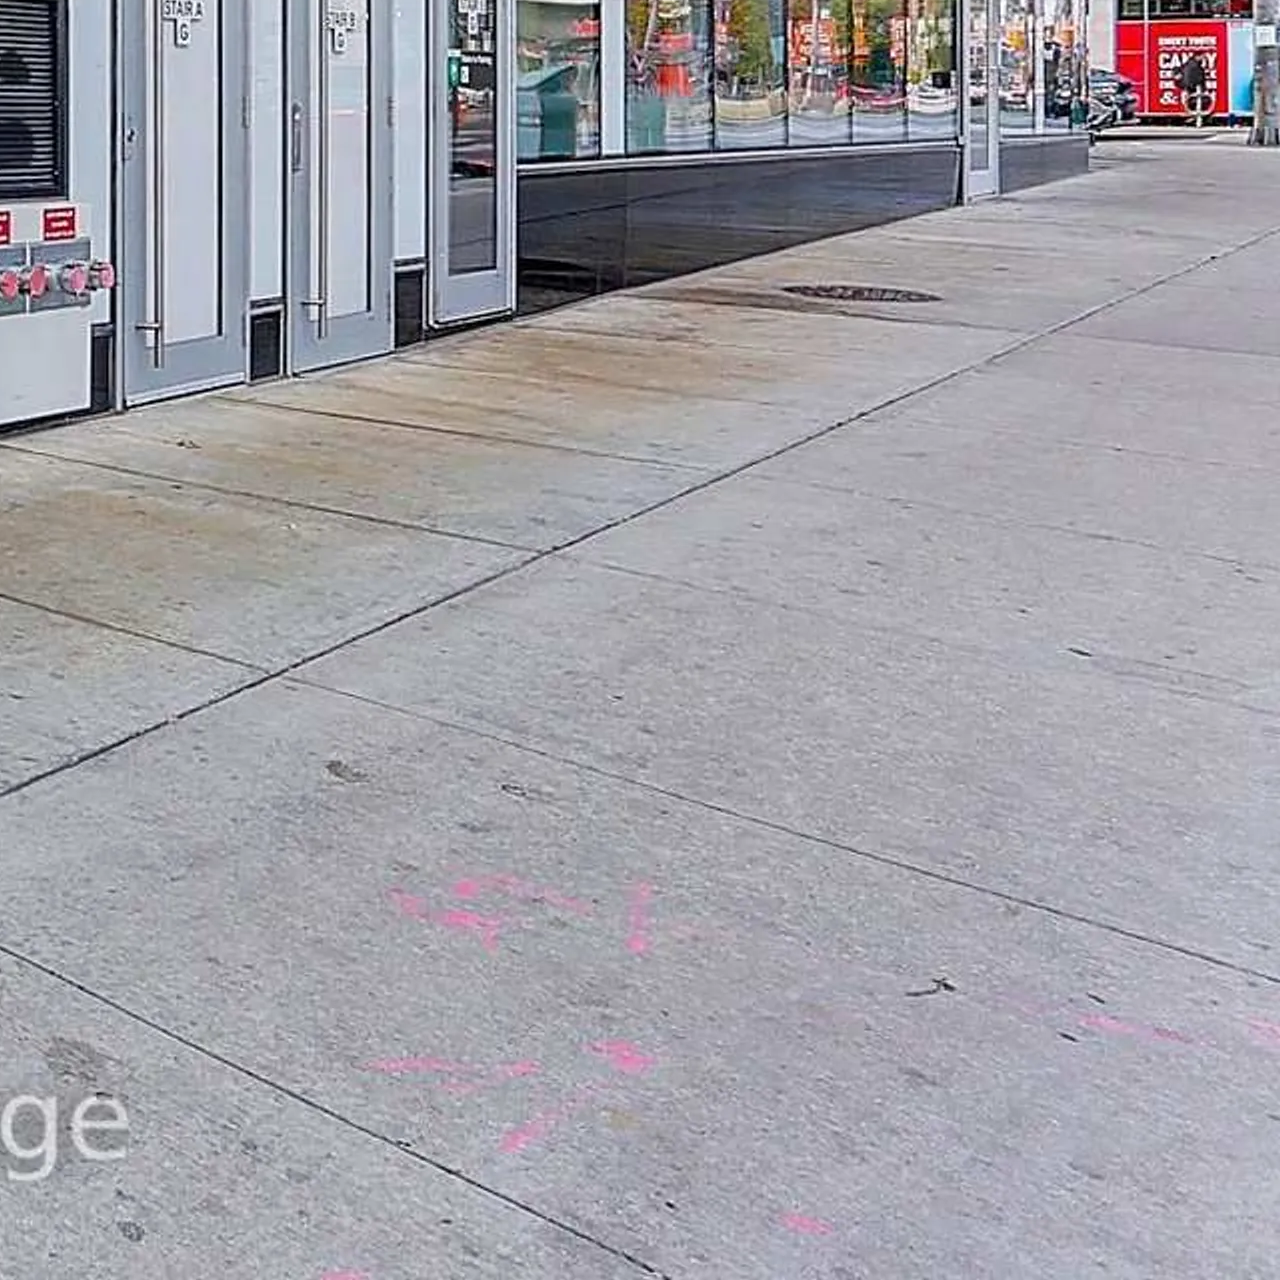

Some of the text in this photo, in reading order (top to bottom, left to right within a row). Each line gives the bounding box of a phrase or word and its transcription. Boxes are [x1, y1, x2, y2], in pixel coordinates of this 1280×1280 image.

[164, 0, 204, 17] STAIR A
[180, 23, 189, 41] G
